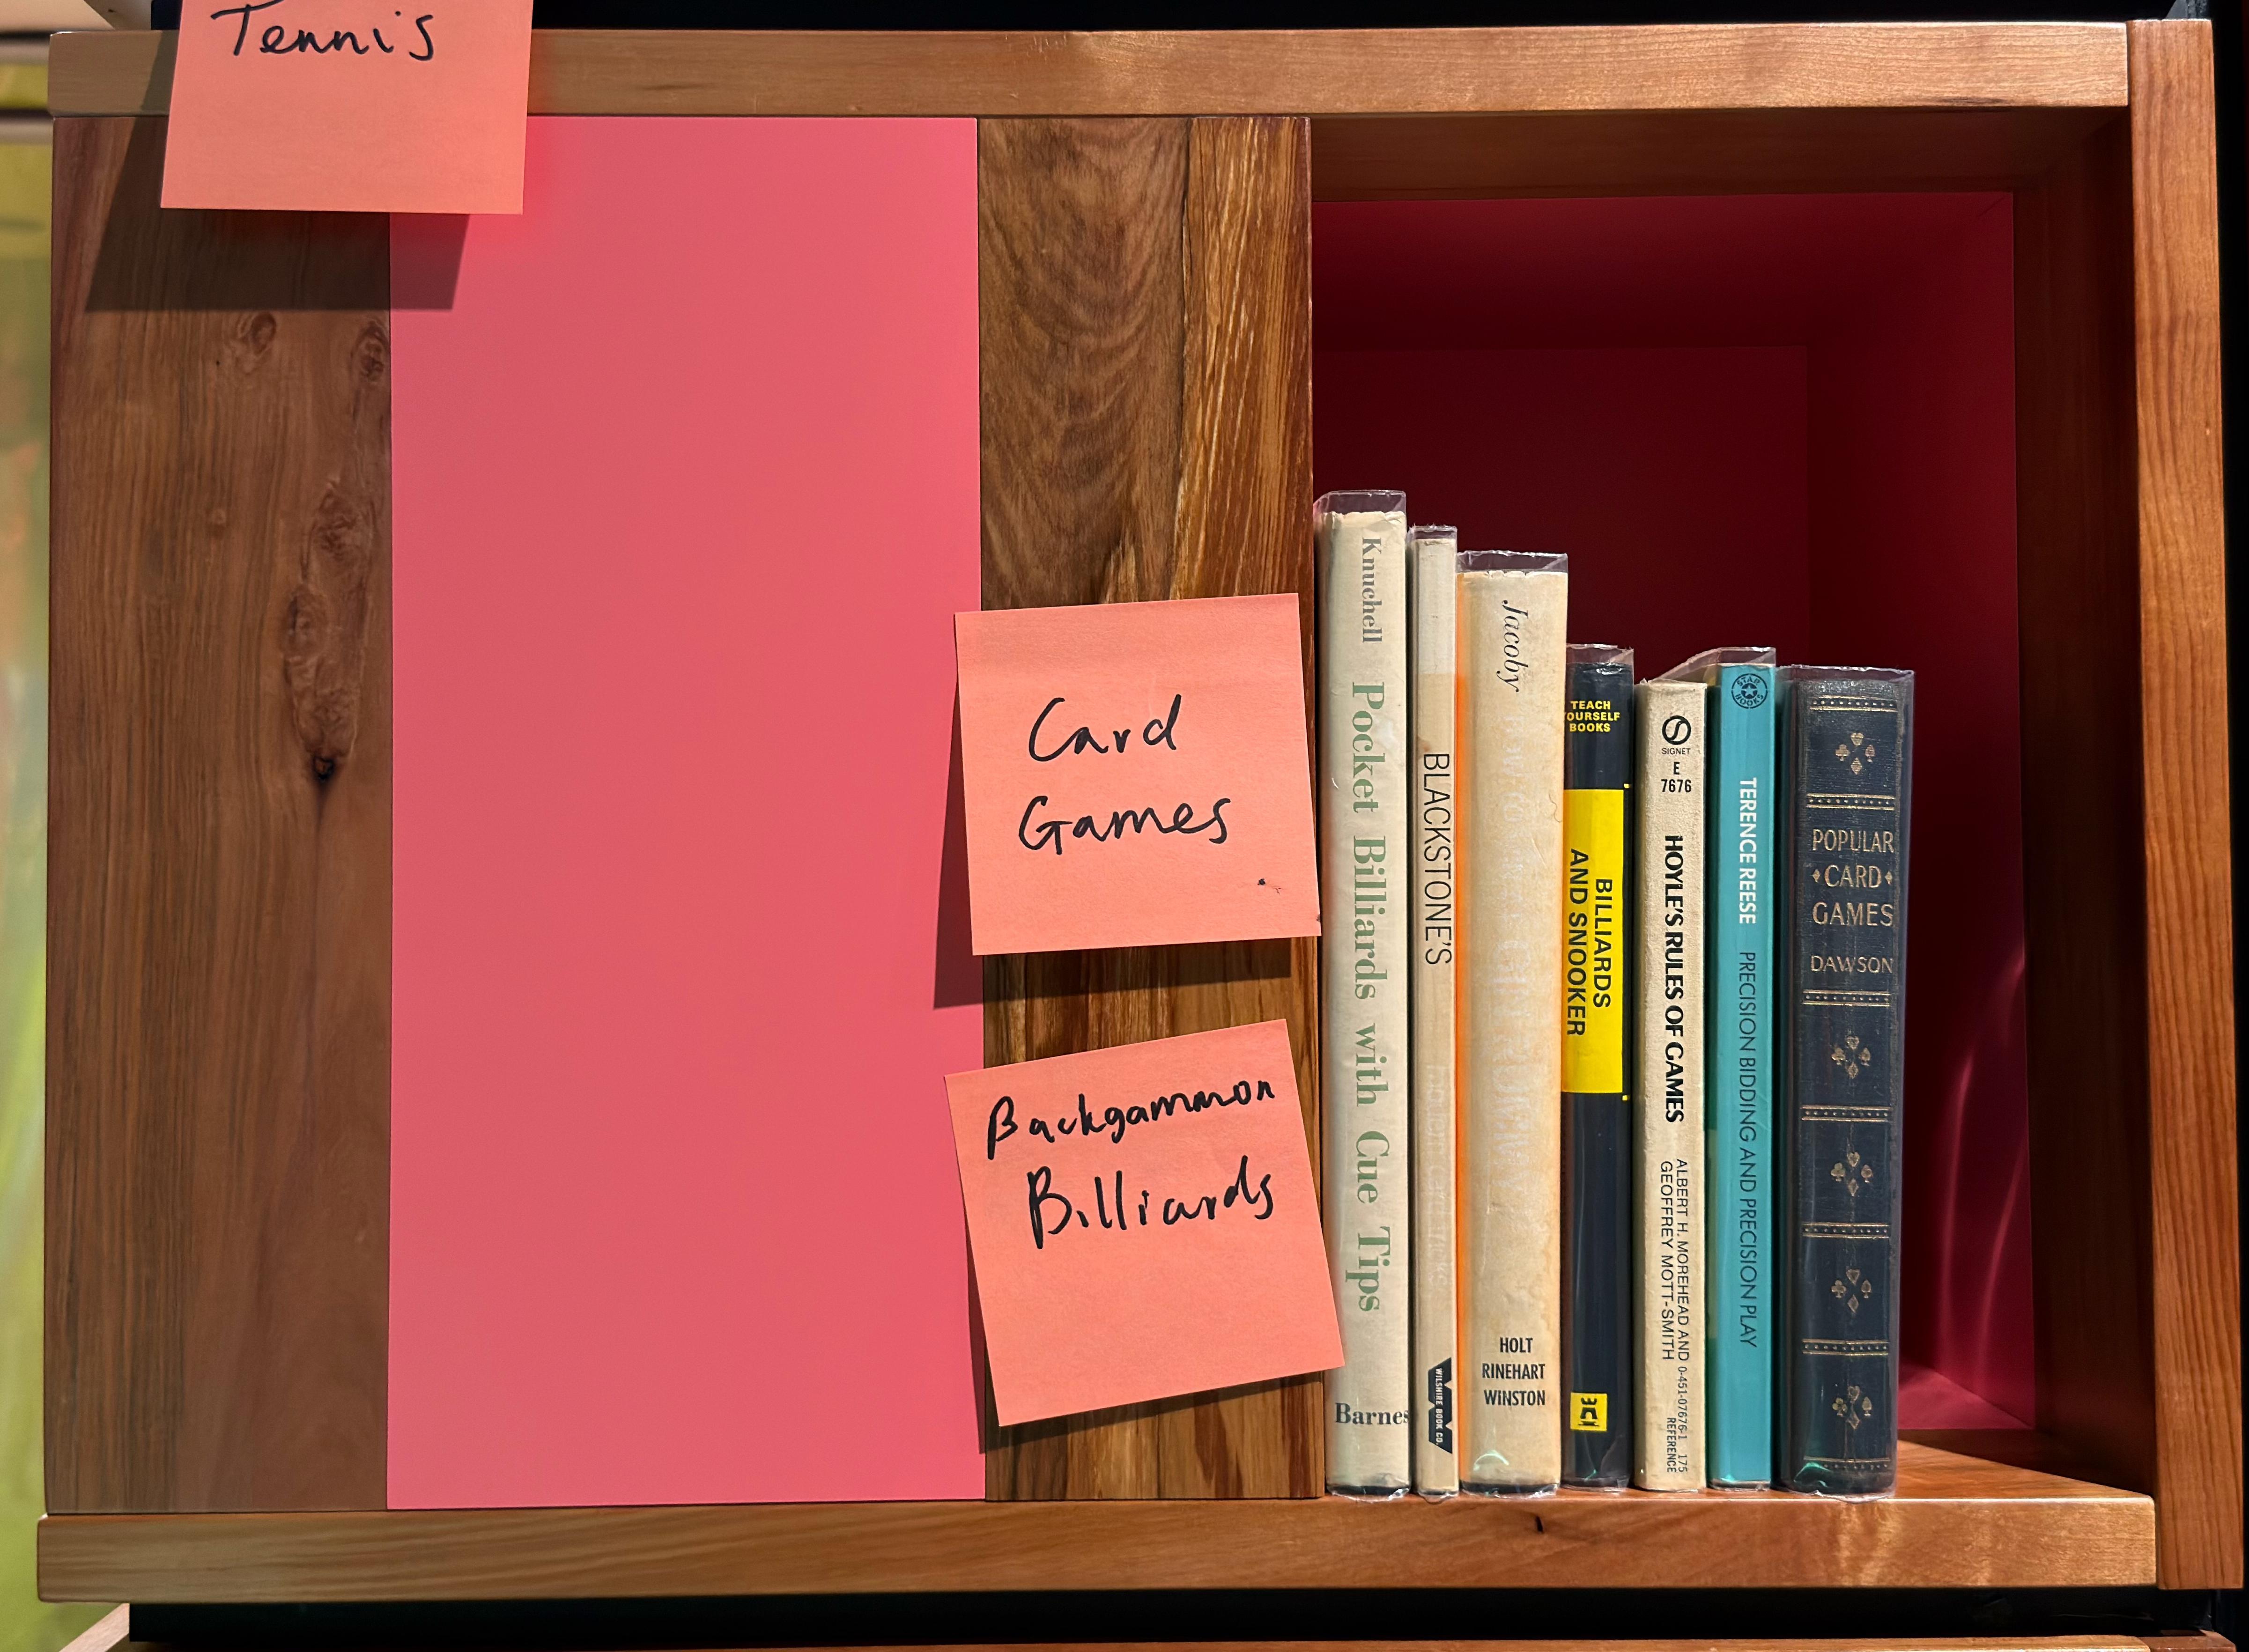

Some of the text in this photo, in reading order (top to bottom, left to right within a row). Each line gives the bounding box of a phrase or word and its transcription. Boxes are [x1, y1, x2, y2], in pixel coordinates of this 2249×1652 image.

[211, 0, 435, 61] Tennis
[1362, 537, 1383, 643] Knuchell
[1496, 600, 1529, 693] Jacoby
[1736, 676, 1761, 686] STAR
[1564, 712, 1620, 722] OURSELF
[1570, 701, 1611, 710] TEACH
[1735, 694, 1764, 707] BOOKS
[1028, 693, 1182, 762] Card
[1569, 723, 1611, 733] BOOKS
[1673, 761, 1680, 775] E
[1661, 779, 1692, 793] 7676
[1018, 795, 1231, 856] Games
[1812, 828, 1894, 853] POPULAR
[1824, 865, 1882, 888] CARD
[1813, 901, 1893, 926] GAMES
[1567, 848, 1589, 1036] AND SNOOKER
[1593, 878, 1613, 1008] BILLIARDS
[1665, 932, 1684, 1000] RULES
[1811, 954, 1893, 973] DAWSON
[1345, 682, 1391, 1312] Pocket Billiards with Cue Tips
[1665, 1004, 1684, 1037] OF
[1739, 777, 1757, 1348] TERENCE REESE PRECISION BIDDING AND PRECISION PLAY
[1665, 1042, 1684, 1123] GAMES
[986, 1079, 1275, 1160] Backgammon
[1027, 1155, 1274, 1250] Billiards
[1661, 1160, 1674, 1360] GEOFFREY MOTT-SMITH
[1676, 1158, 1689, 1362] ALBERT H. MOREHEAD AND
[1500, 1337, 1533, 1353] HOLT
[1435, 1368, 1443, 1406] WILSHIRE
[1482, 1363, 1546, 1379] RINEHART
[1484, 1390, 1546, 1406] WINSTON
[1435, 1432, 1443, 1446] CO.
[1667, 1416, 1677, 1474] REFERENCE
[1678, 1453, 1688, 1474] 175
